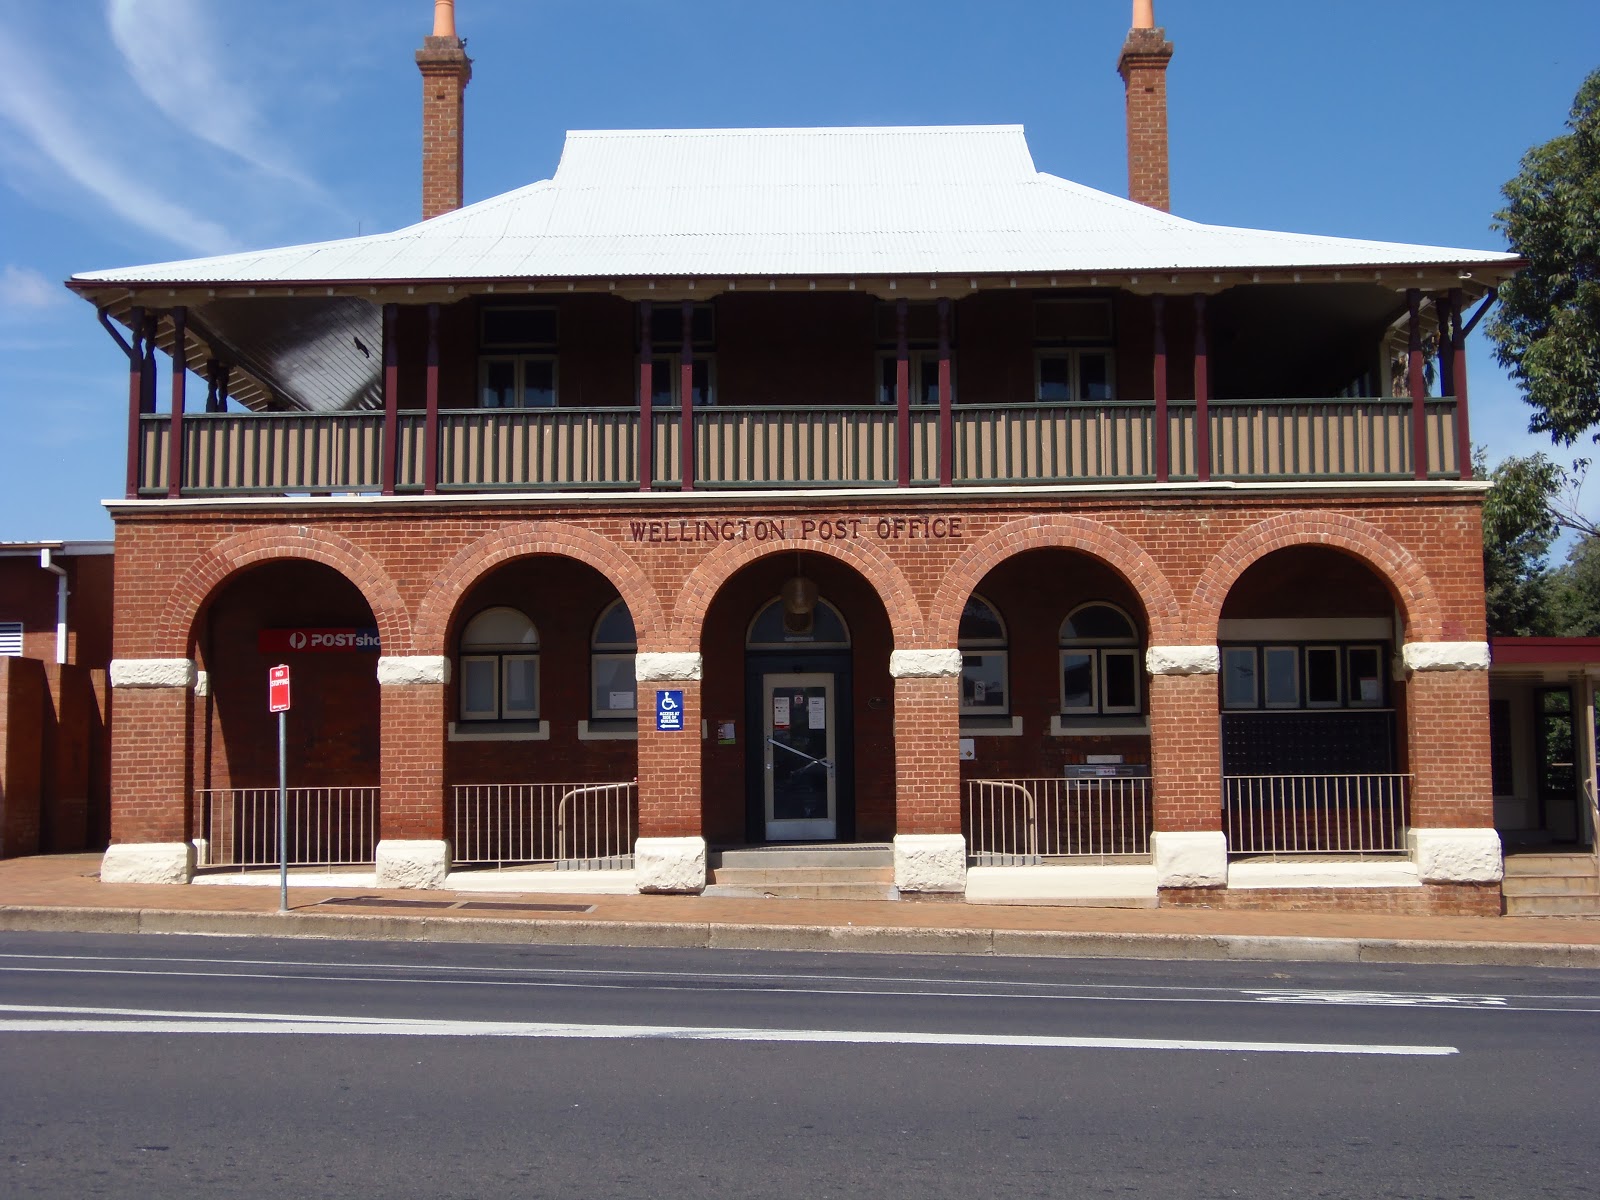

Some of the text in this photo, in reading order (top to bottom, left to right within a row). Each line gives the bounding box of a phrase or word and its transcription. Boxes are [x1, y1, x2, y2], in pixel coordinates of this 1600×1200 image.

[630, 517, 962, 542] WELLINGTON POST OFFICE
[275, 670, 284, 678] NO
